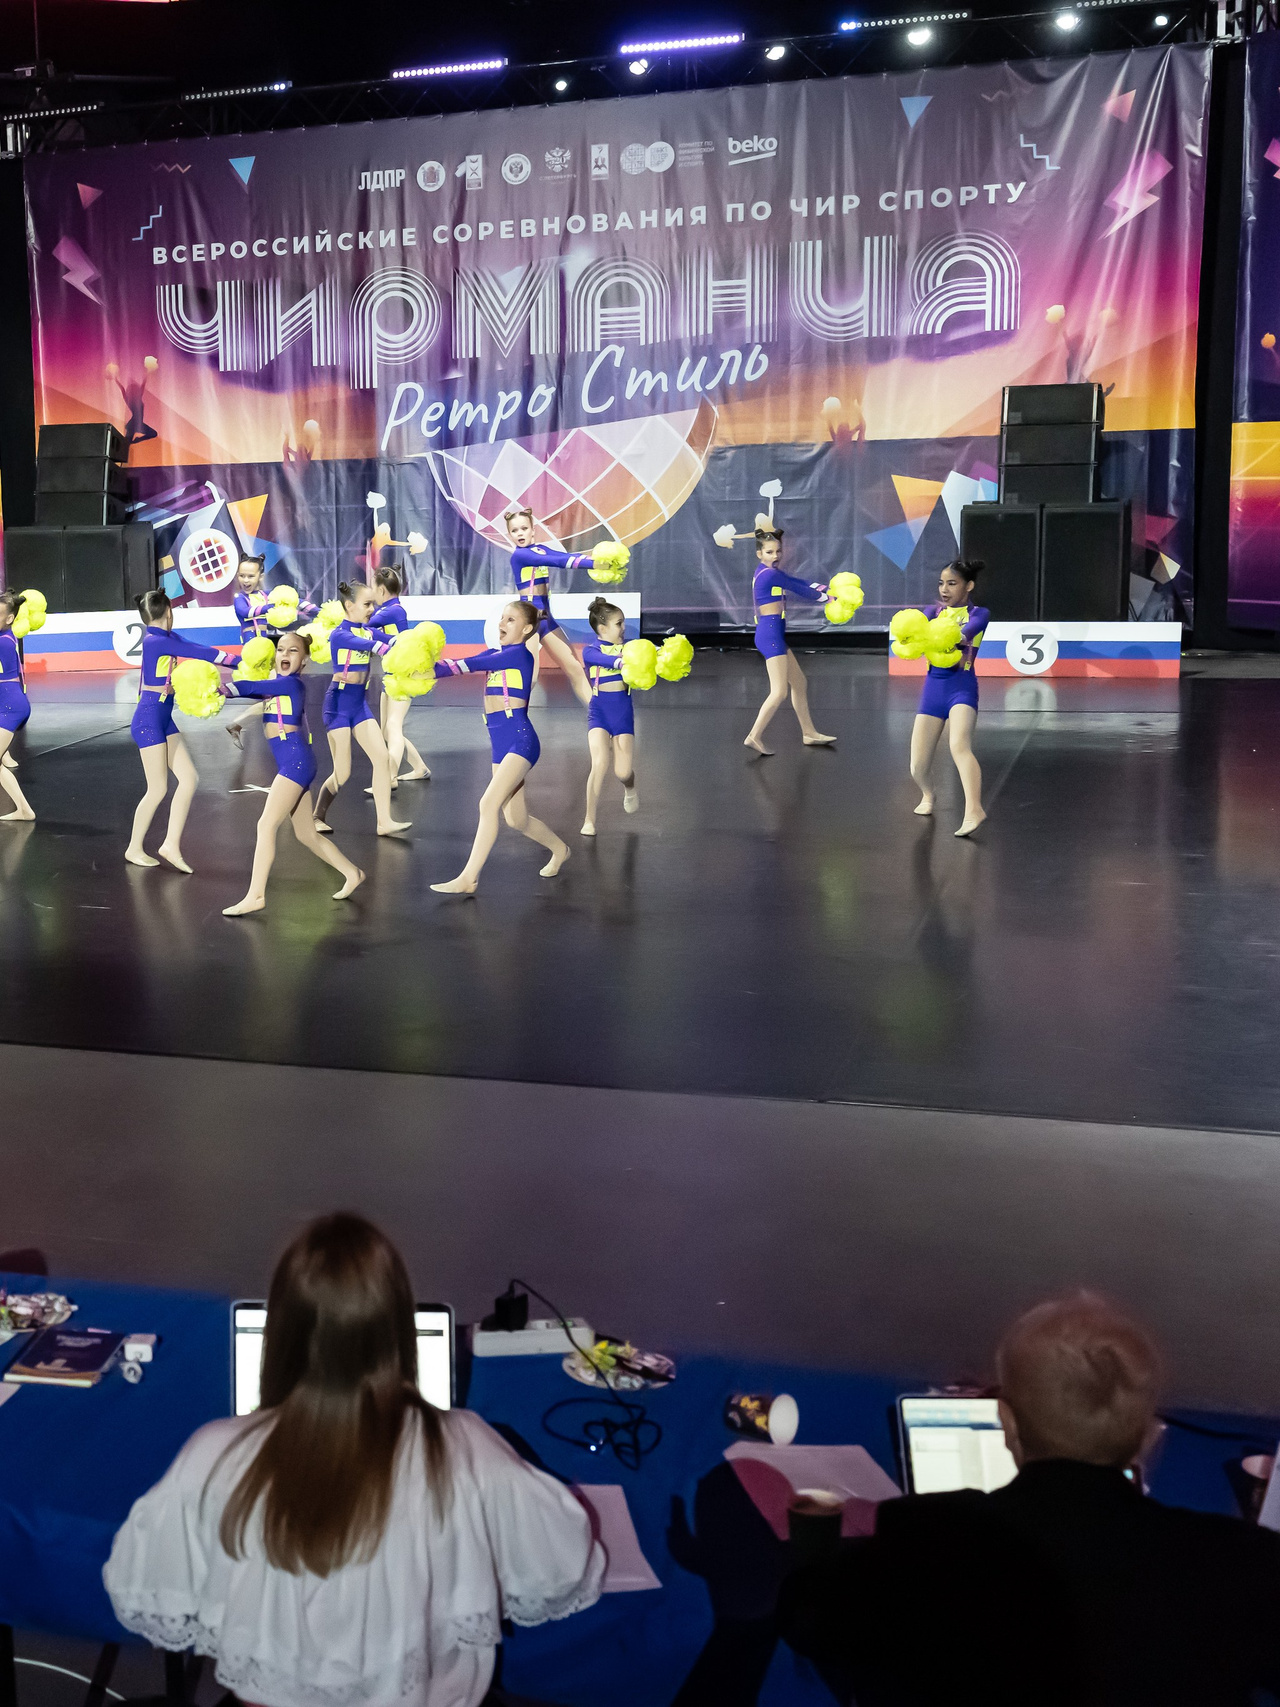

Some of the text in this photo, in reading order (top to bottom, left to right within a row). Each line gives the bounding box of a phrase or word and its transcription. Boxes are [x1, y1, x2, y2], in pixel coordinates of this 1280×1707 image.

[728, 136, 778, 153] beko
[358, 169, 406, 192] ЛДПР
[152, 182, 1026, 265] ВСЕРОССИЙСКИЕ СОРЕВНОВАНИЯ ПО ЧИР СПОРТУ
[381, 344, 769, 451] Ретро Стиль
[126, 623, 147, 656] 2
[1020, 633, 1045, 665] 3
